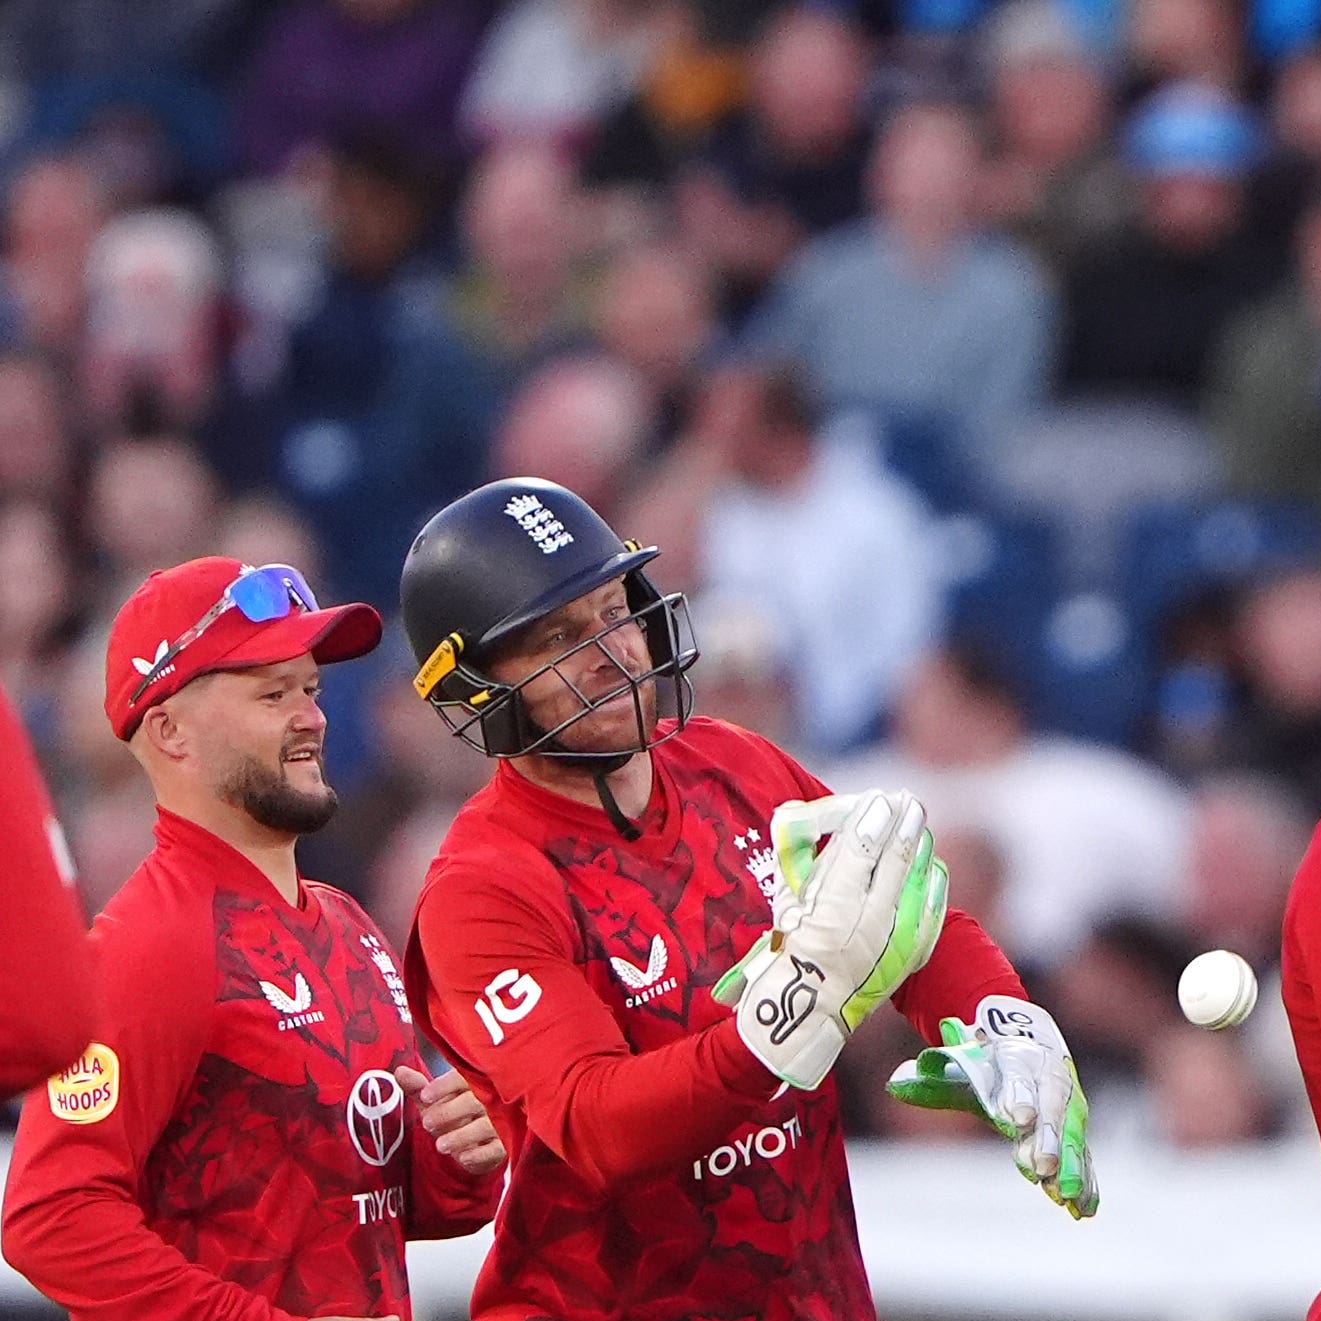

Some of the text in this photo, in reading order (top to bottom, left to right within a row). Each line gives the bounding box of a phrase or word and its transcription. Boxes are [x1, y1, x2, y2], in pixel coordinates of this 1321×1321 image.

[474, 968, 543, 1046] IG
[625, 976, 678, 1009] CASTORE
[278, 1010, 325, 1031] CASTORE
[57, 1082, 111, 1111] HOOPS
